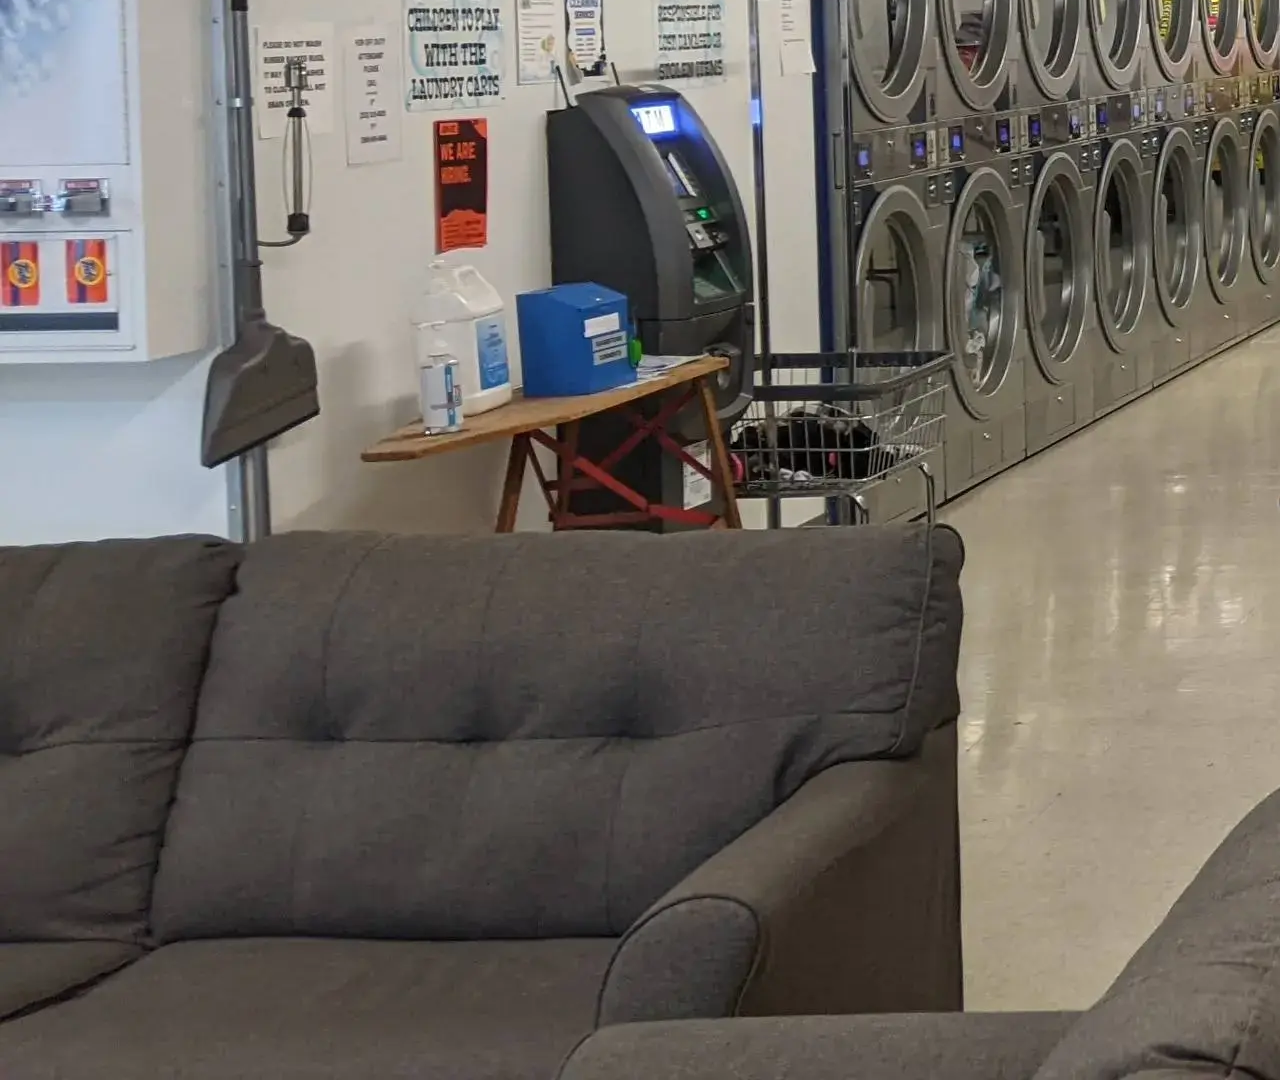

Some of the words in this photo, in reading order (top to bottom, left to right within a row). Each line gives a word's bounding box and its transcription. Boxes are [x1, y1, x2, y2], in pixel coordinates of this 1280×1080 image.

[408, 7, 459, 32] CHILDREN
[461, 7, 474, 31] TO
[475, 7, 500, 32] PLAY
[424, 43, 459, 67] WITH
[461, 43, 486, 65] THE
[412, 77, 464, 100] LAUNDRY
[466, 75, 500, 96] CARTS
[440, 143, 454, 160] WE
[456, 141, 476, 159] ARE
